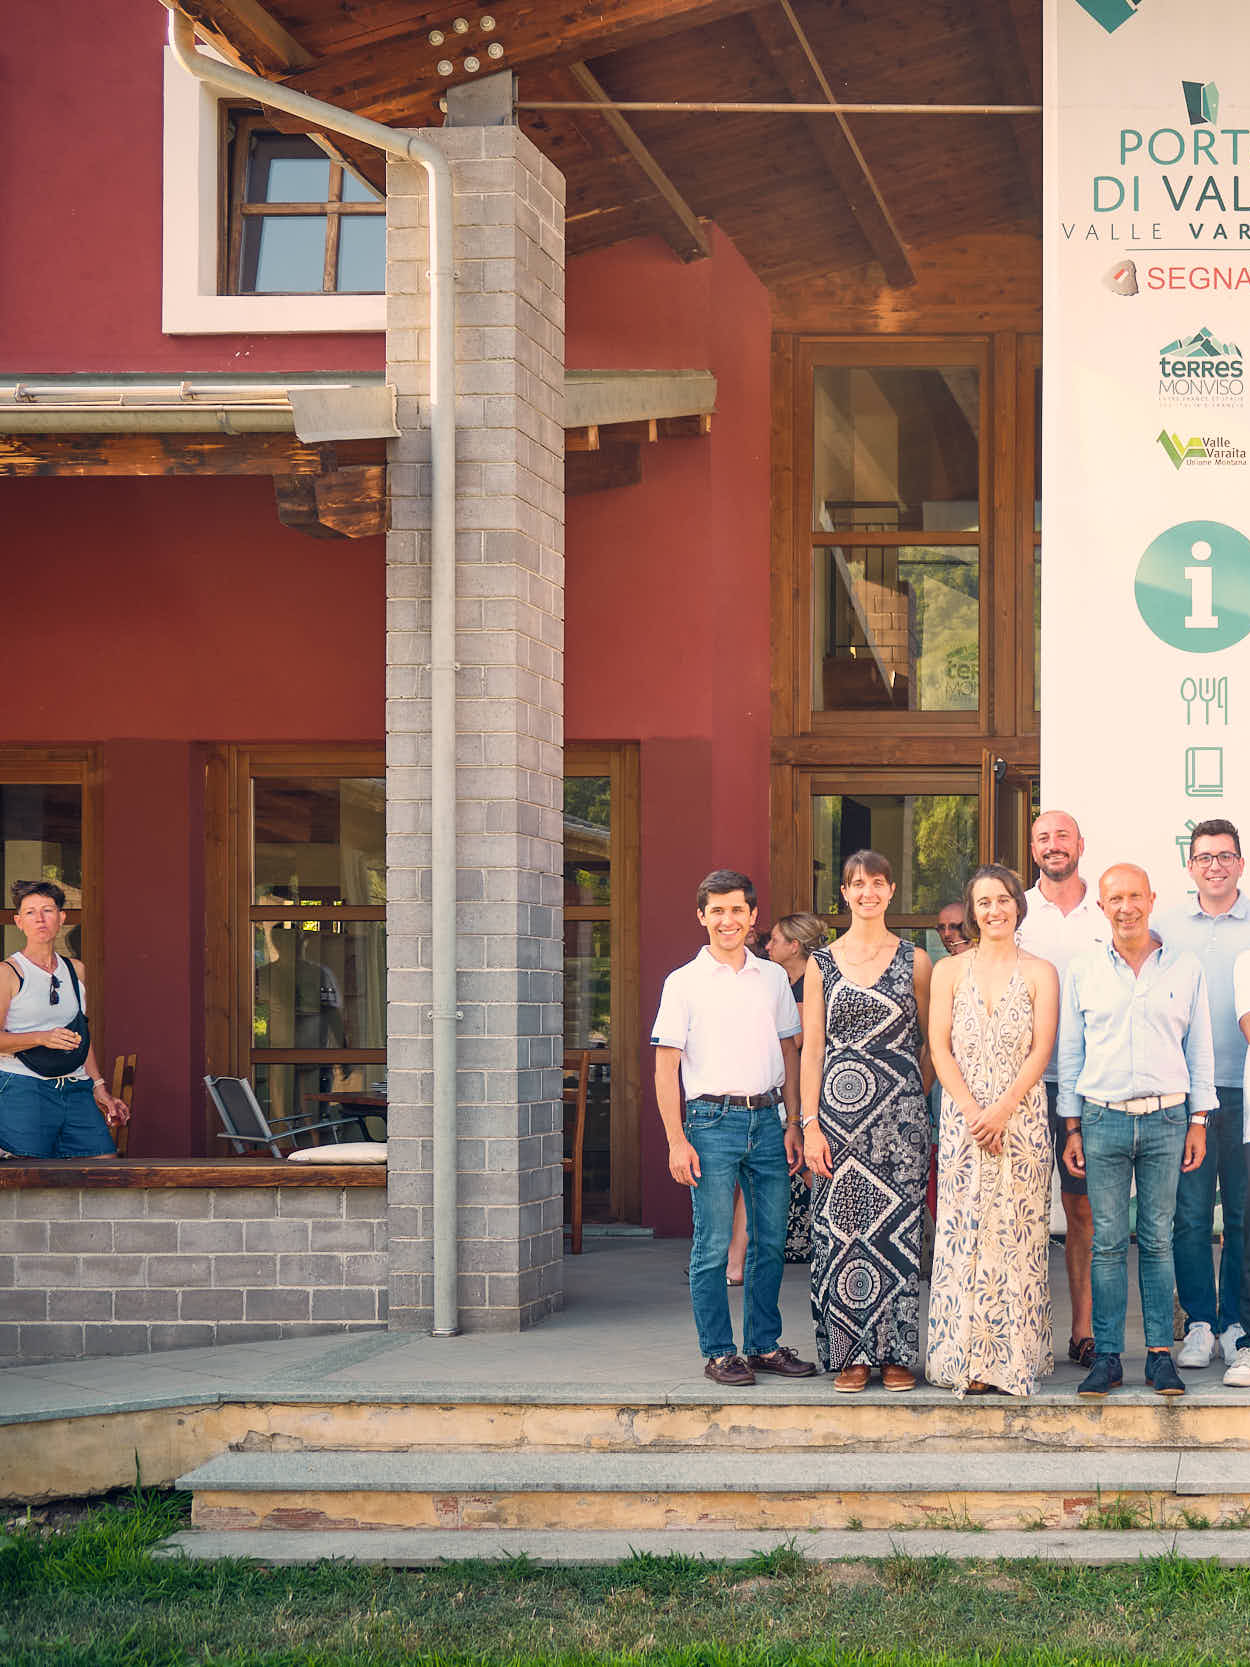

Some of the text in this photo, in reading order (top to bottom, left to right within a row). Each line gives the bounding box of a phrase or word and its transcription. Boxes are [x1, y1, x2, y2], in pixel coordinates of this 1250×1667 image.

[1093, 175, 1140, 213] DI
[1061, 223, 1162, 241] VALLE
[1158, 379, 1244, 395] MONVISO
[1202, 437, 1231, 448] Valle
[1206, 448, 1247, 459] Varaita
